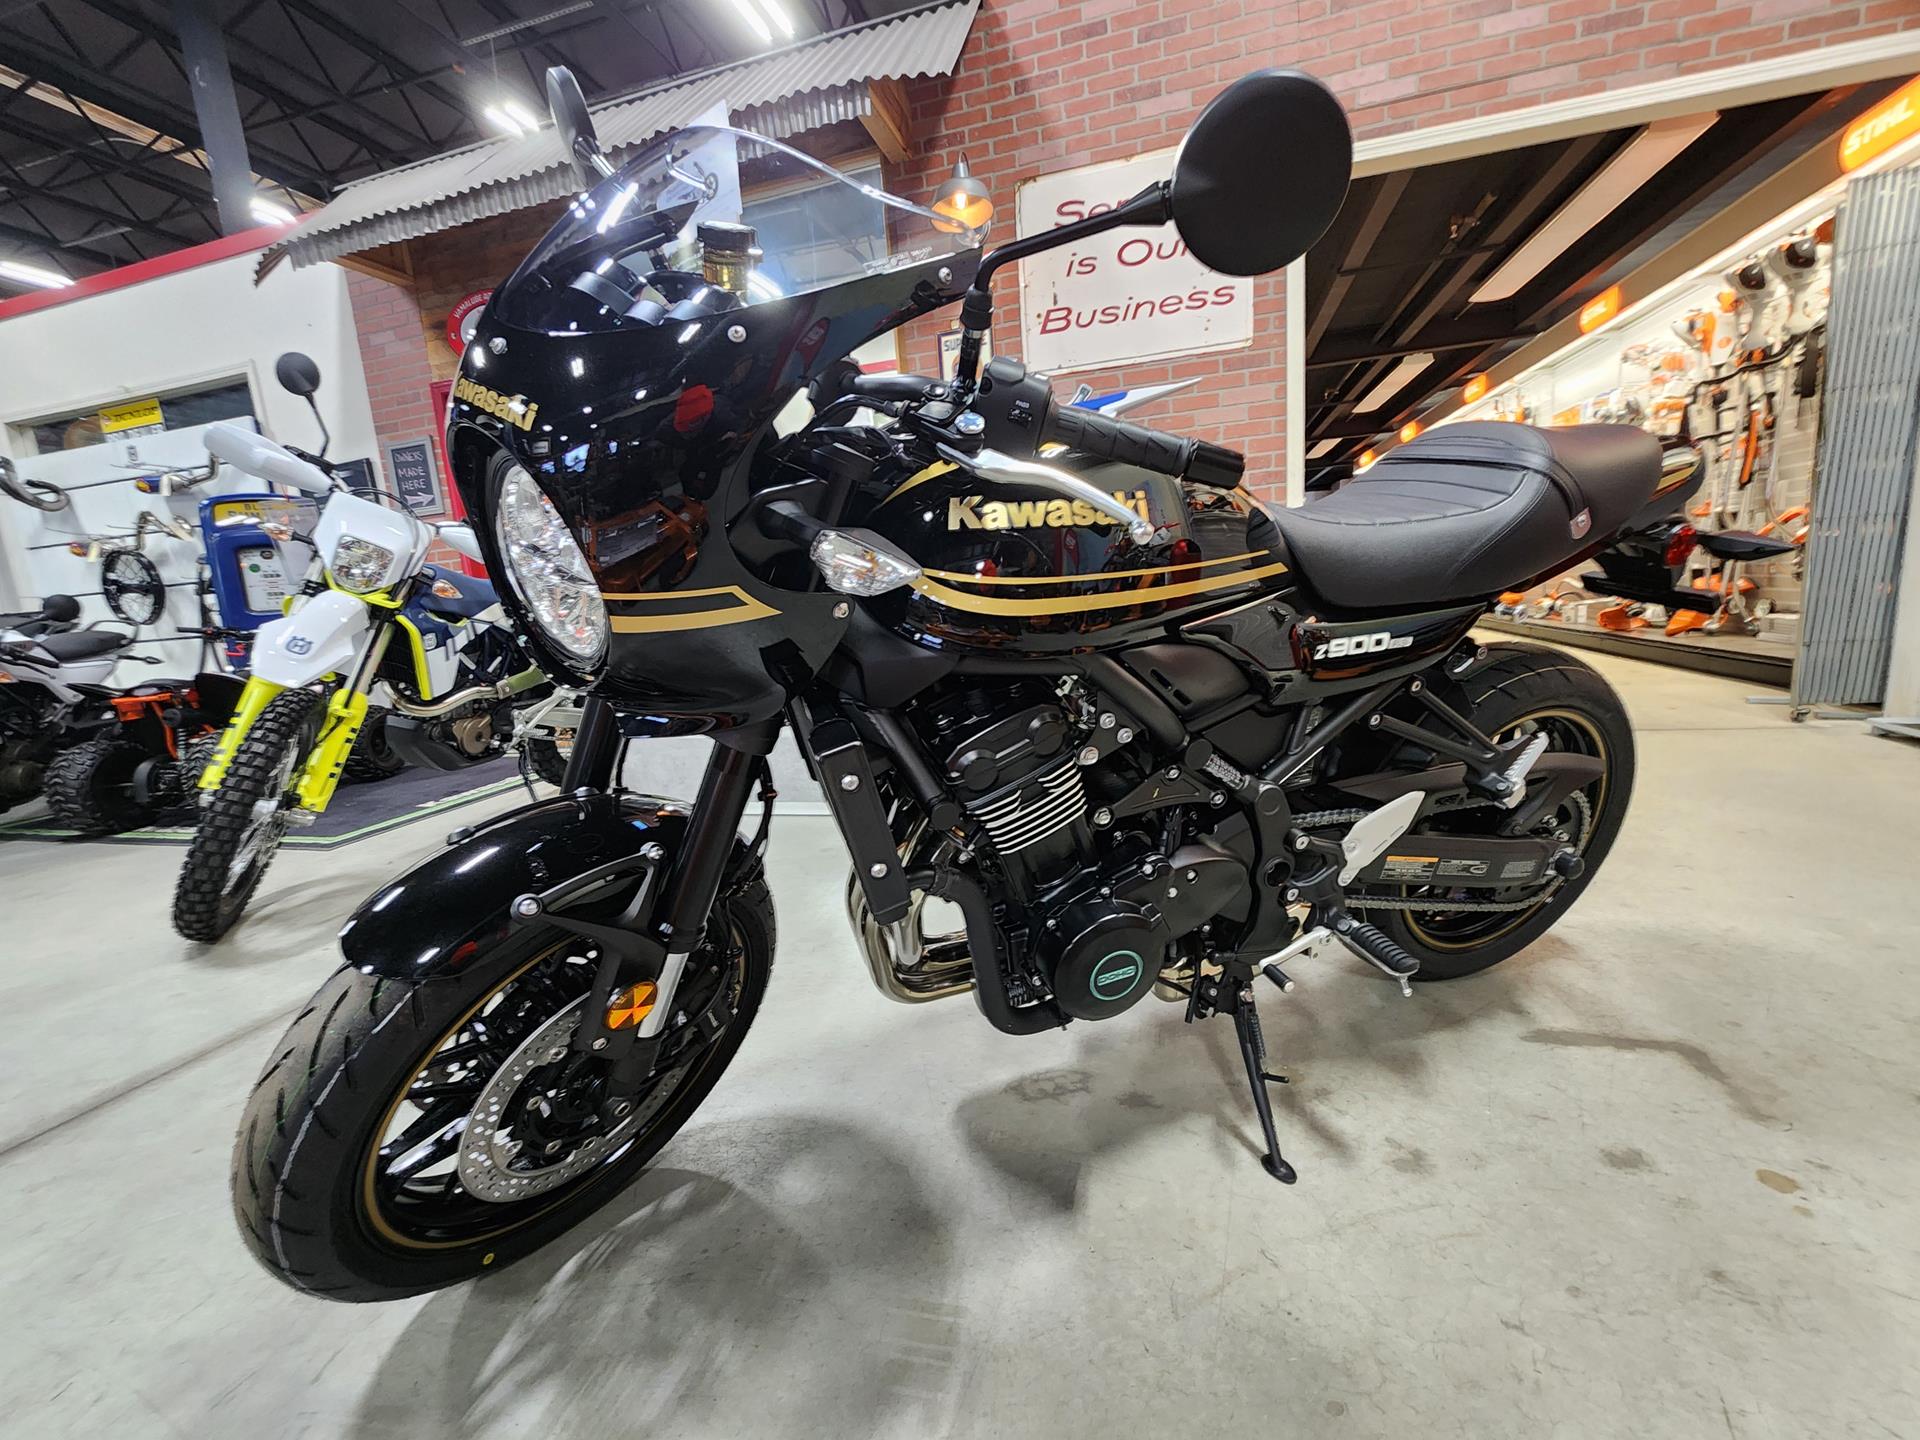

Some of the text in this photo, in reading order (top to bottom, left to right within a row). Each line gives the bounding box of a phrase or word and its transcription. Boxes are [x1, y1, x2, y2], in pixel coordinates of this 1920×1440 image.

[1066, 253, 1097, 278] is
[1039, 285, 1236, 335] Business
[398, 466, 426, 478] MADE
[402, 478, 427, 491] HERE
[1097, 966, 1137, 986] DOHC
